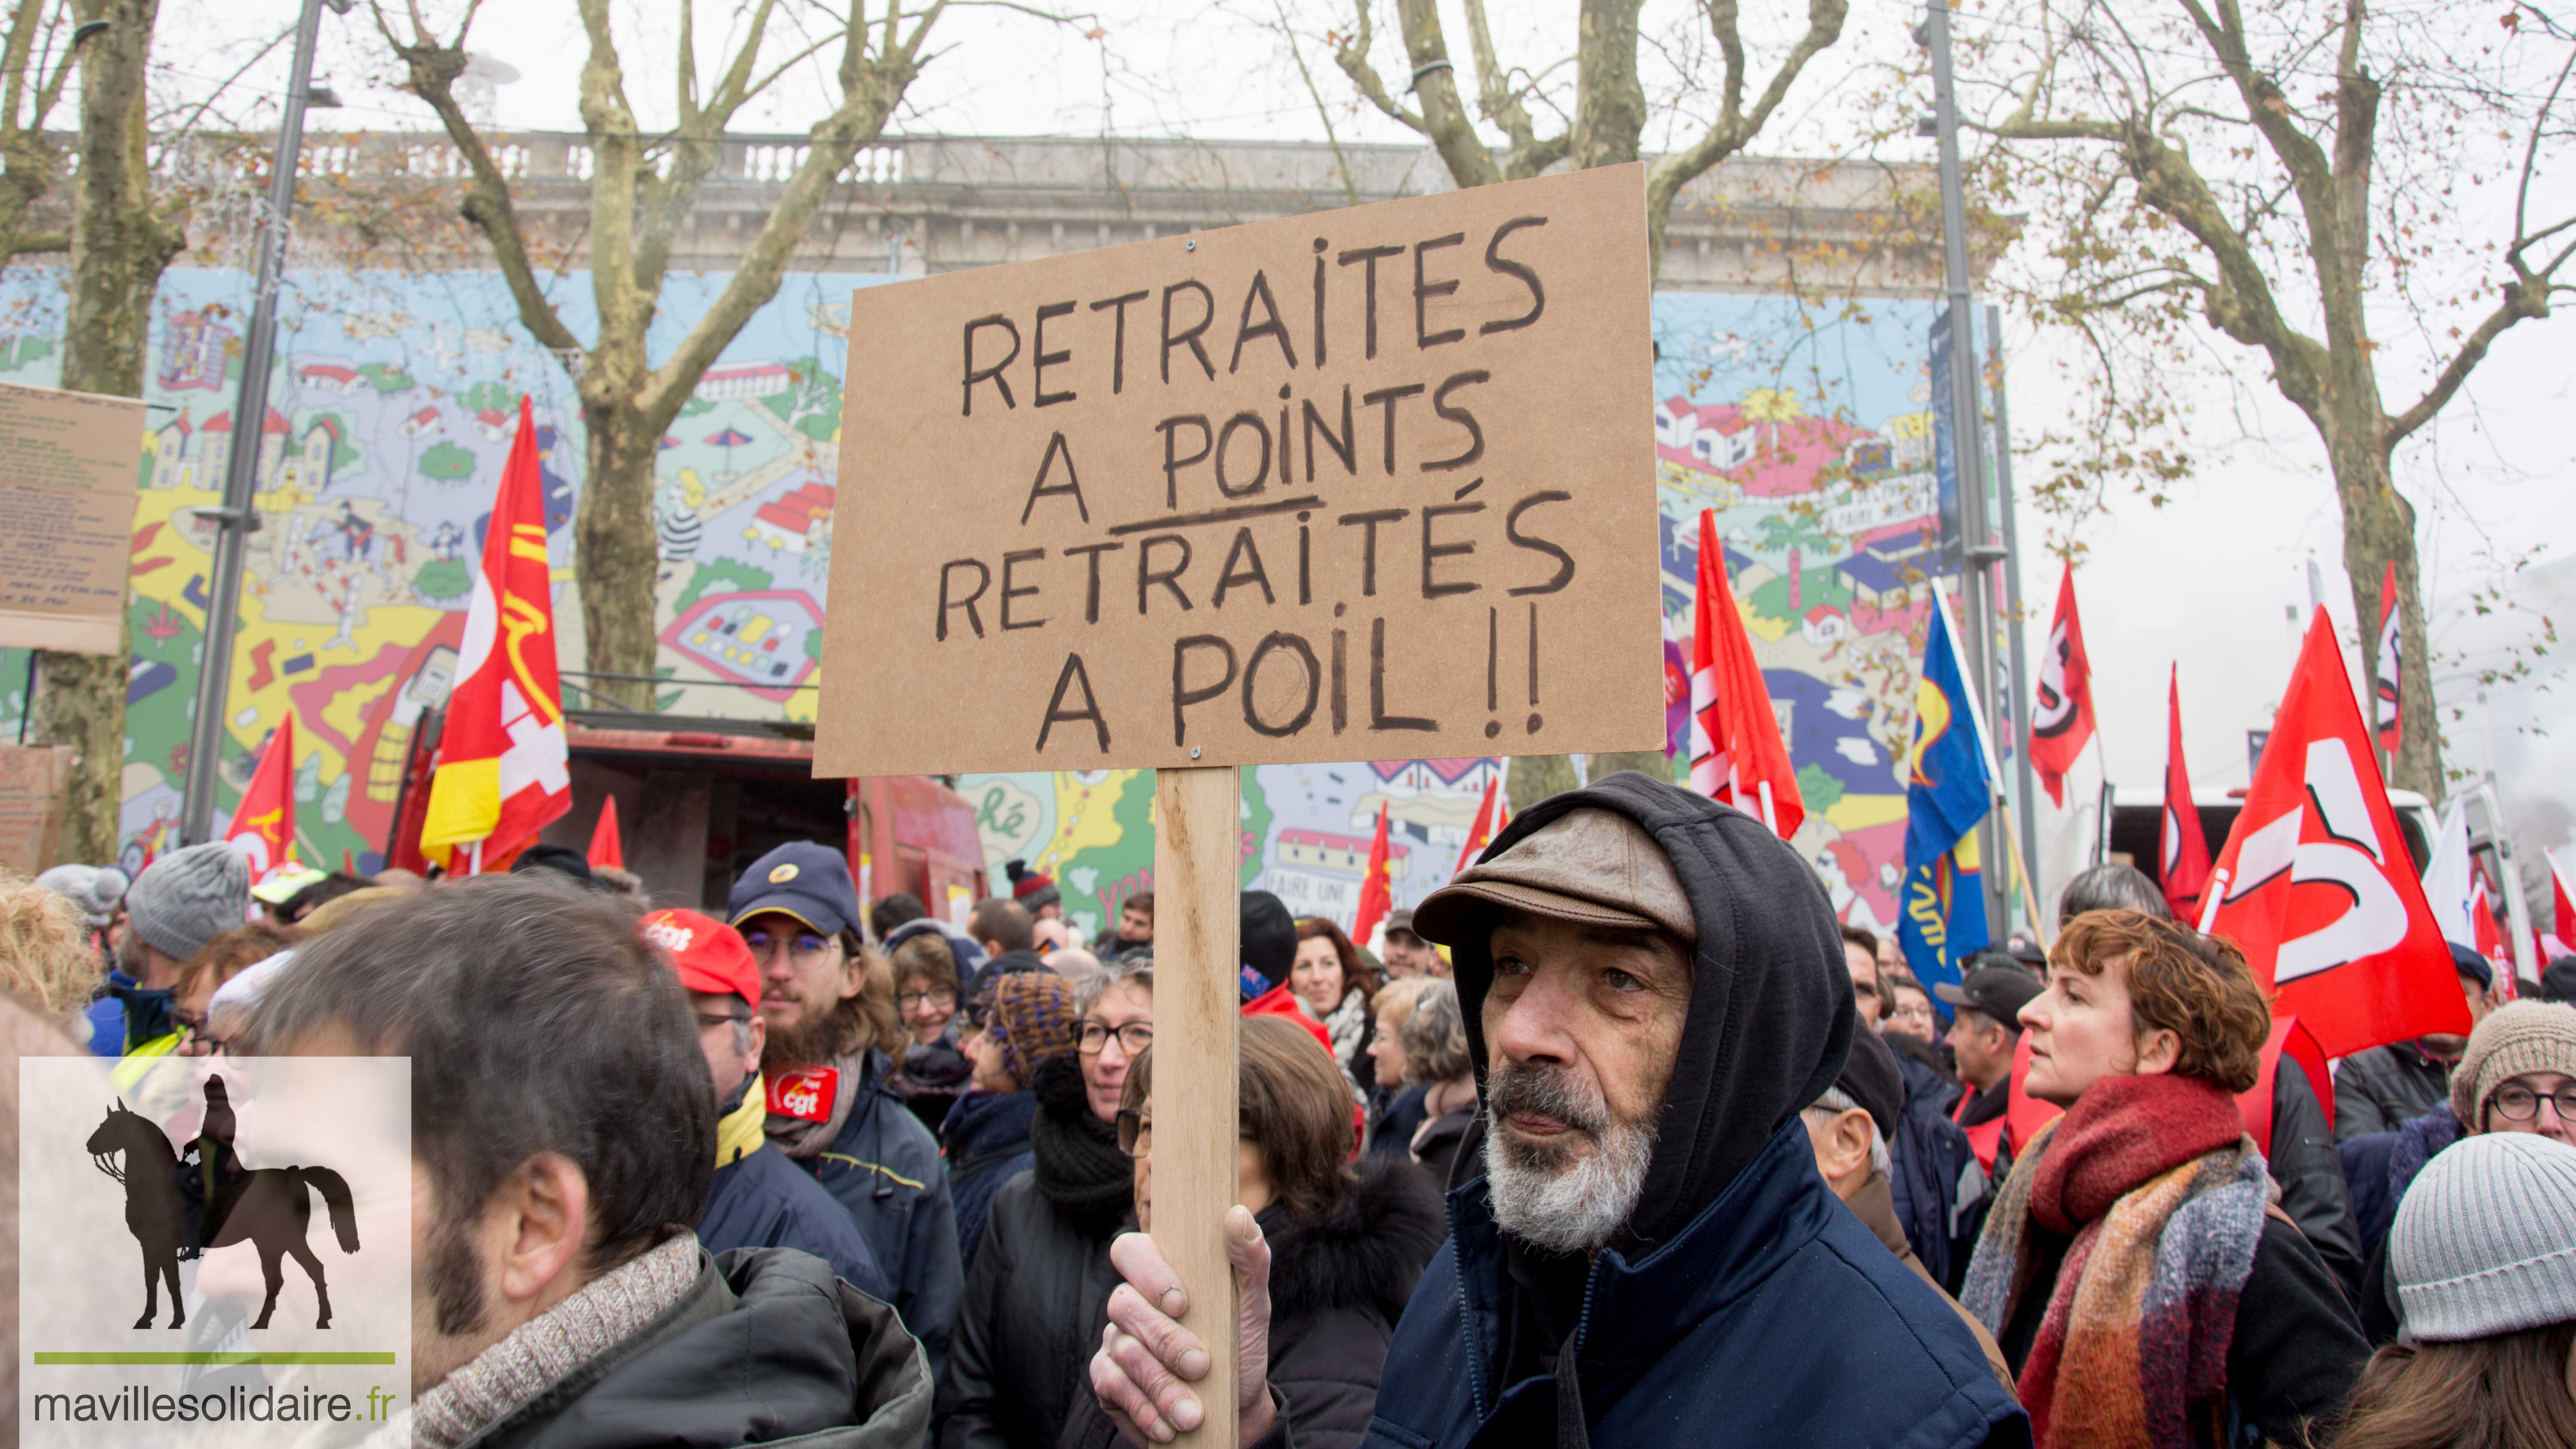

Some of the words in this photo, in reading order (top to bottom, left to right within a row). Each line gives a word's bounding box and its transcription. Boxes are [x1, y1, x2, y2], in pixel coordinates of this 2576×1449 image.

[1021, 431, 1089, 525] A
[1036, 652, 1111, 753] A
[1269, 870, 1309, 902] FAIRE
[1318, 880, 1345, 904] UNE
[783, 1091, 819, 1117] cgt
